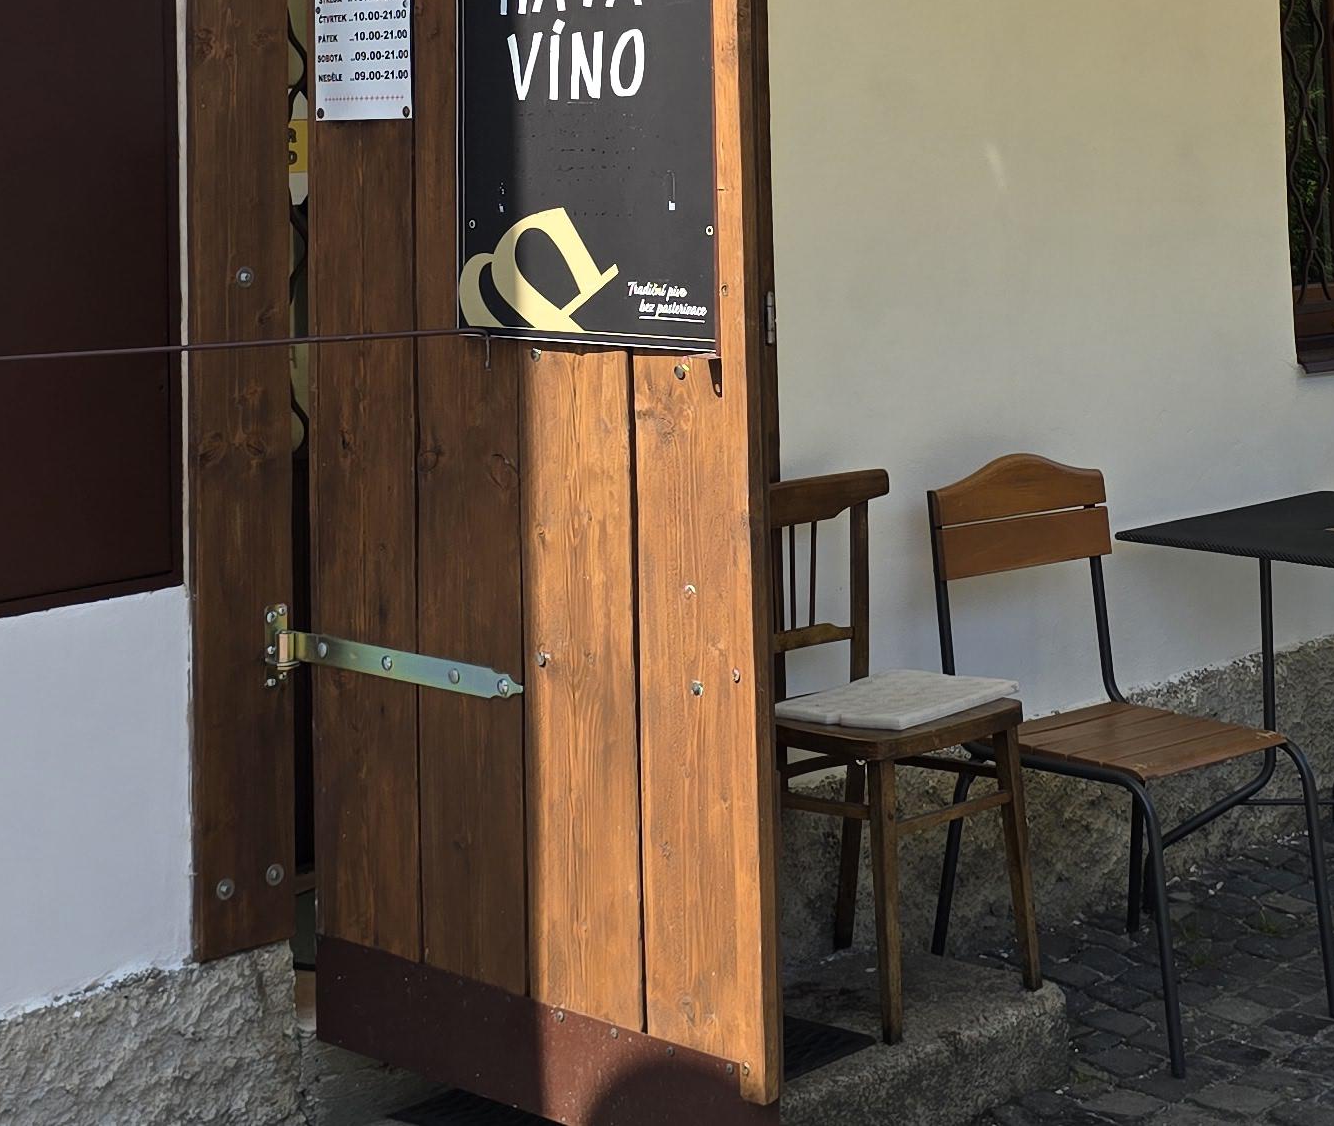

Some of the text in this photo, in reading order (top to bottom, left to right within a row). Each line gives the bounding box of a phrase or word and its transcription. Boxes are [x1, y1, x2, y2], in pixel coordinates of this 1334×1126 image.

[507, 19, 646, 102] VÍNO
[665, 285, 688, 302] pivo
[638, 298, 655, 313] bez
